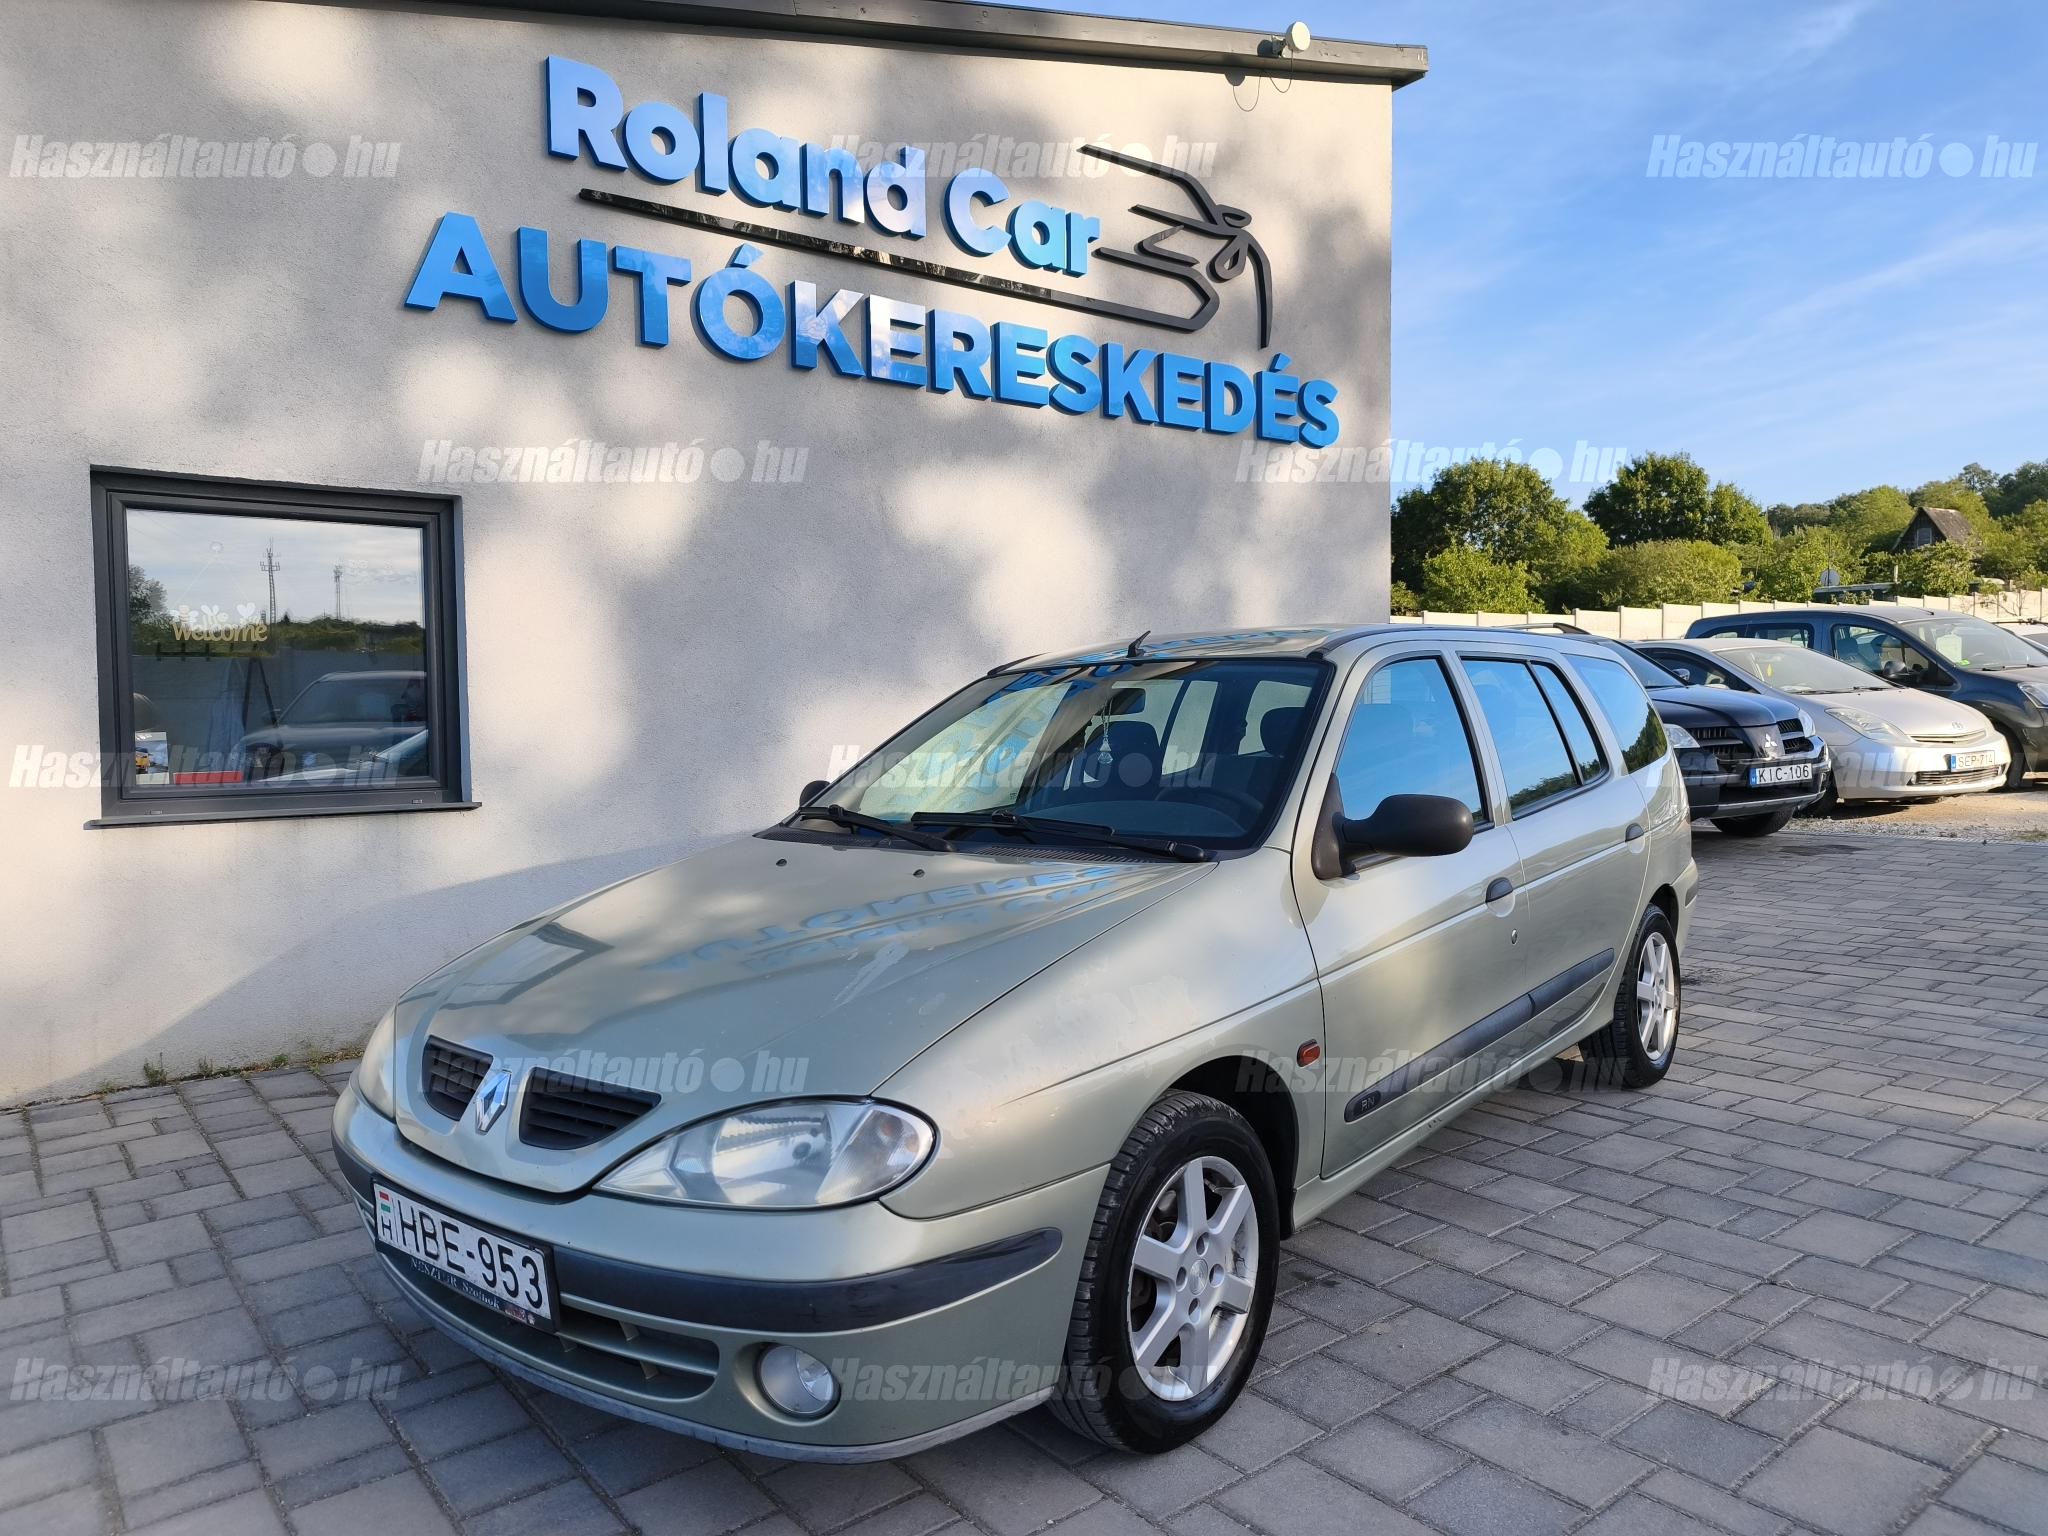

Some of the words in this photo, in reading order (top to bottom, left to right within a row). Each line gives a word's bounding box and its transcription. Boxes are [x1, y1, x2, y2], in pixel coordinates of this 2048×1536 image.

[546, 55, 926, 239] Roland
[944, 168, 1101, 277] Car
[405, 212, 1340, 448] AUTÓKERESKEDÉS
[170, 617, 268, 642] Welcome
[1758, 765, 1810, 783] KIC-106
[1958, 754, 1993, 768] SEP-714
[381, 1215, 393, 1242] H
[398, 1199, 543, 1310] HBE-953
